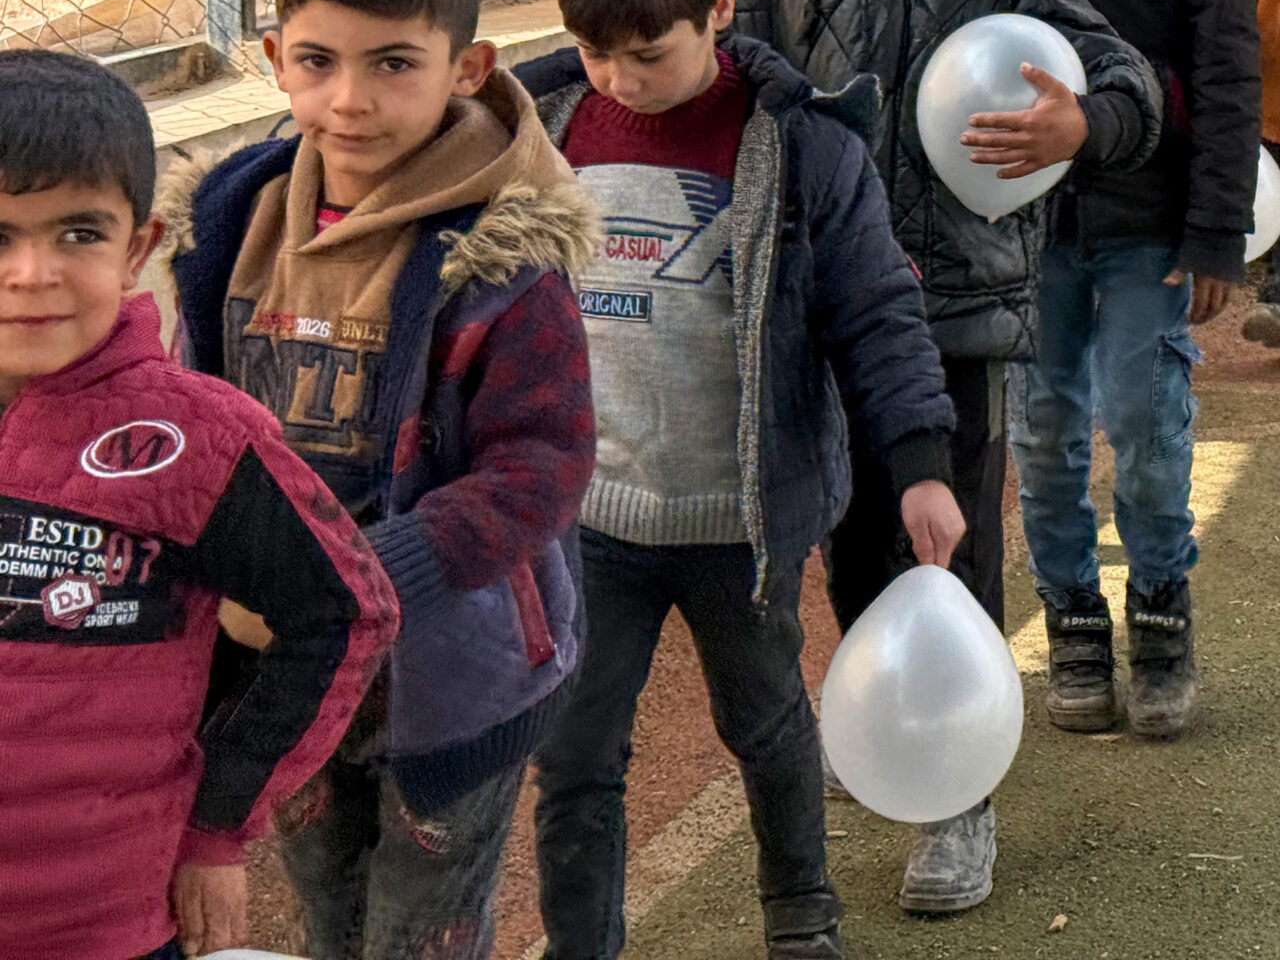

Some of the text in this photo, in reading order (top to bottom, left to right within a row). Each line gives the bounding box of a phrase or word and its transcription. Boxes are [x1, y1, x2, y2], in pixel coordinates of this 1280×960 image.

[605, 236, 666, 262] CASUAL
[296, 318, 331, 338] 2026
[27, 516, 104, 549] ESTD
[55, 586, 86, 611] DJ
[84, 614, 115, 628] SPORT
